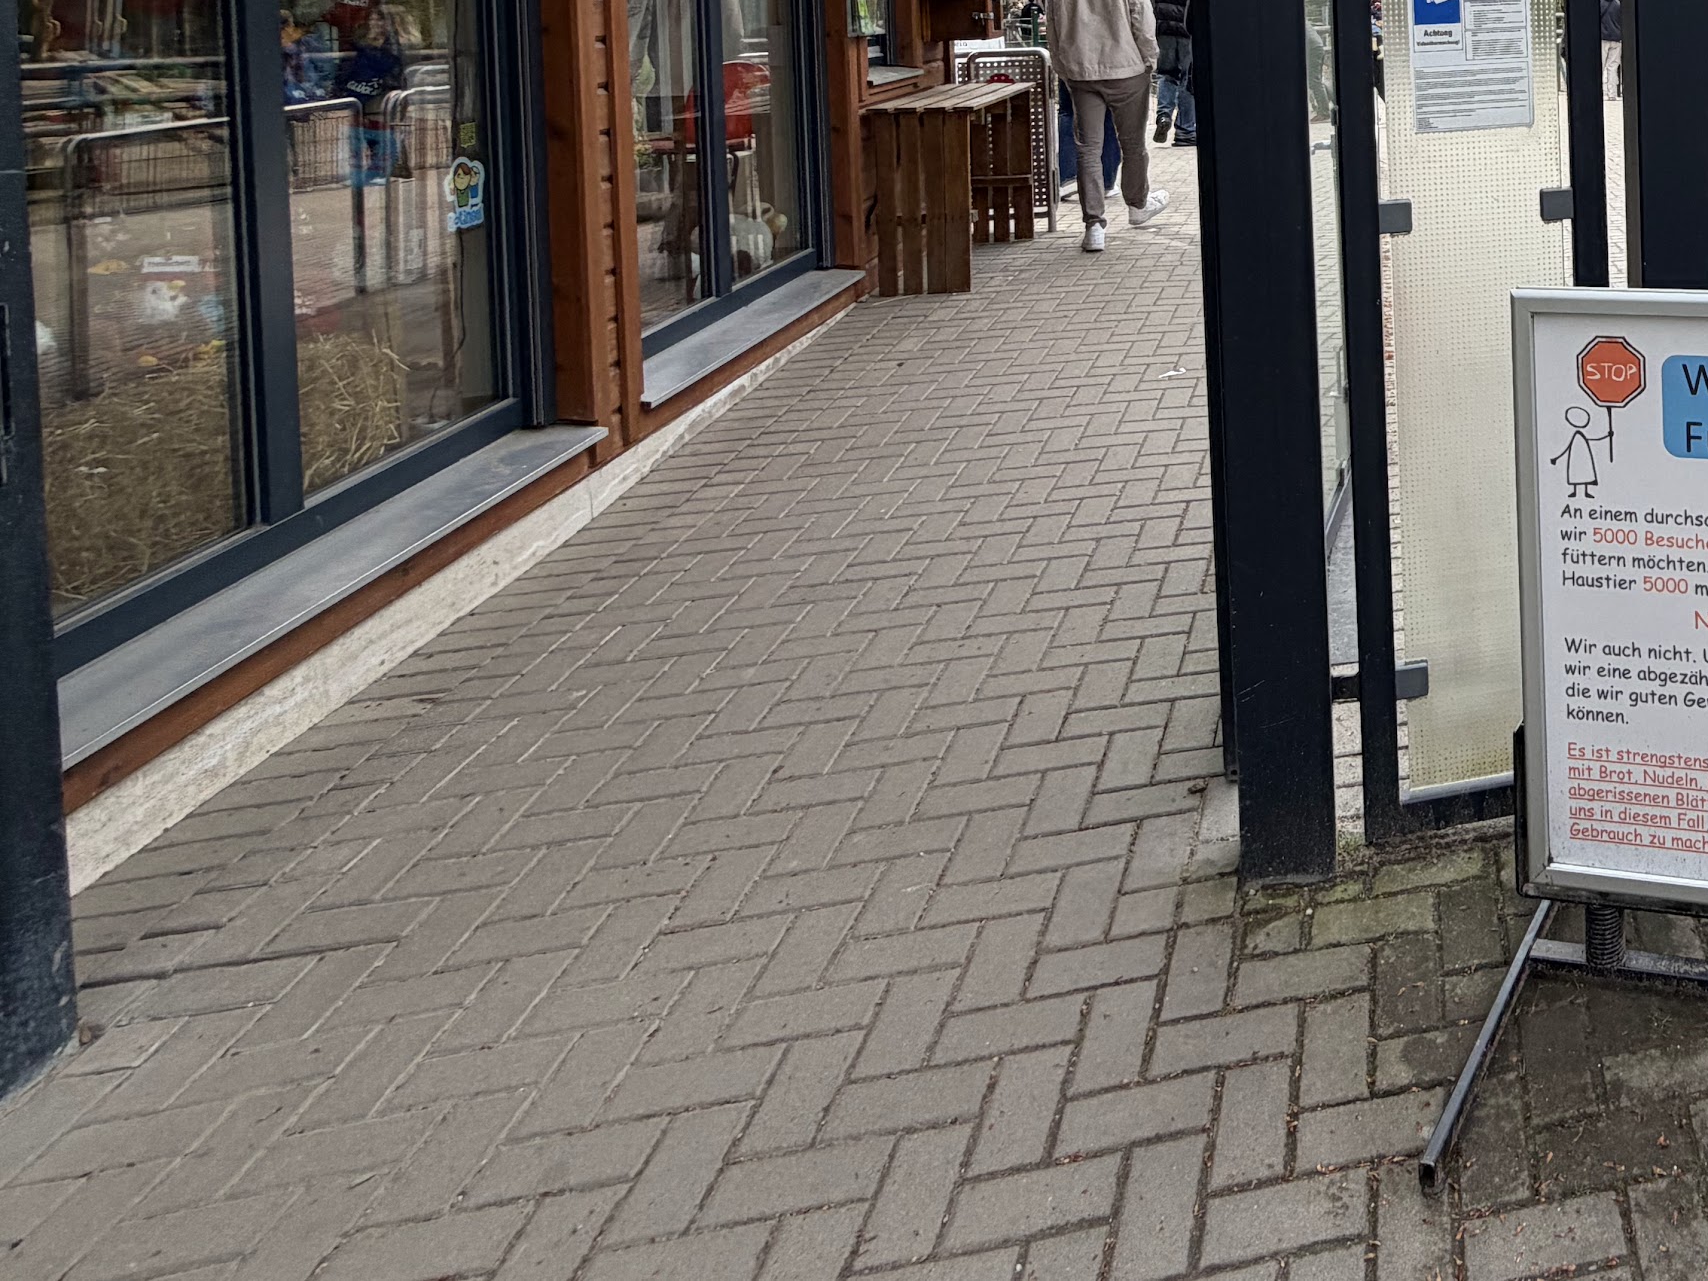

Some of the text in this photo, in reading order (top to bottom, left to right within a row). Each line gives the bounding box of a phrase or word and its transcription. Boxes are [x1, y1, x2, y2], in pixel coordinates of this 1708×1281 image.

[1423, 29, 1453, 37] Achtung
[1586, 363, 1637, 382] STOP
[1560, 504, 1583, 519] An
[1588, 505, 1638, 523] einem
[1560, 526, 1587, 542] wir
[1593, 527, 1638, 545] 5000
[1561, 548, 1626, 568] füttern
[1562, 570, 1637, 590] Haustier
[1643, 576, 1689, 594] 5000
[1564, 637, 1597, 654] Wir
[1602, 641, 1642, 659] auch
[1648, 645, 1697, 664] nicht.
[1564, 660, 1591, 676] wir
[1596, 663, 1632, 680] eine
[1565, 682, 1592, 699] die
[1596, 685, 1624, 701] wir
[1628, 690, 1678, 707] guten
[1566, 703, 1629, 725] können.
[1567, 742, 1586, 758] Es
[1591, 744, 1612, 759] ist
[1568, 764, 1594, 778] mit
[1599, 765, 1638, 784] Brot,
[1643, 769, 1703, 790] Nudeln,
[1568, 783, 1670, 806] abgerissenen
[1569, 805, 1595, 818] uns
[1600, 805, 1613, 820] in
[1618, 807, 1672, 826] diesem
[1569, 822, 1643, 843] Gebrauch
[1649, 834, 1666, 846] zu
